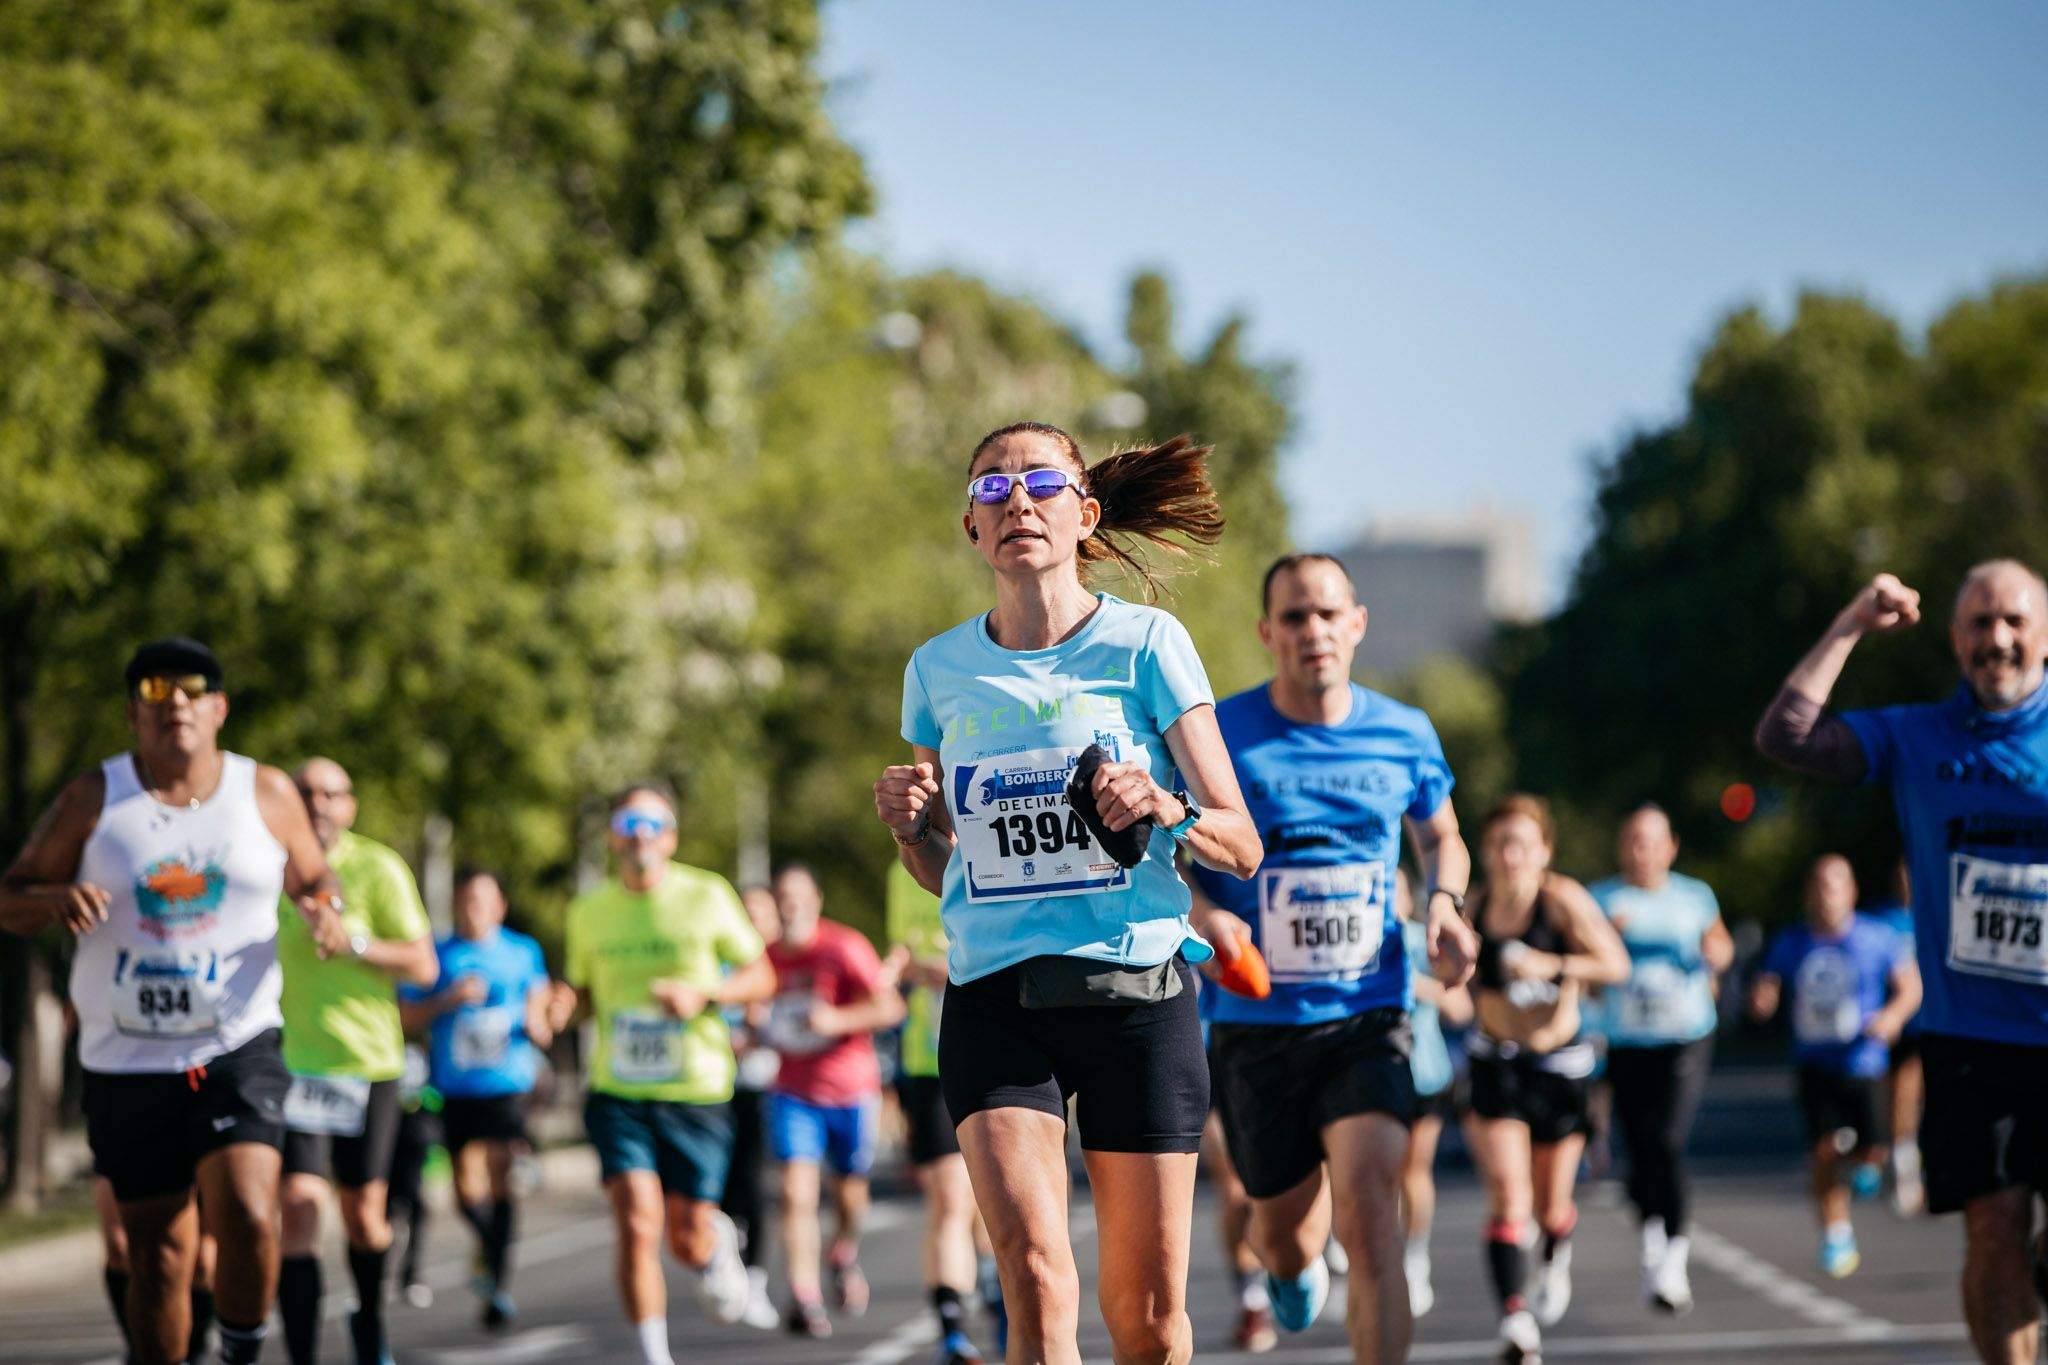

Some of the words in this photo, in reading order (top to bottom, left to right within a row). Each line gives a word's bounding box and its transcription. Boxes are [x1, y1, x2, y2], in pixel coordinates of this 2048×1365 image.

[944, 696, 1122, 744] ECIMA
[988, 745, 1027, 757] CARRERA
[1004, 770, 1072, 786] BOMBERO
[1005, 766, 1033, 774] CARRERA
[999, 794, 1072, 812] DECIMA
[989, 811, 1091, 858] 1394
[1289, 915, 1361, 949] 1506
[1974, 909, 2041, 949] 1873
[138, 986, 191, 1017] 934
